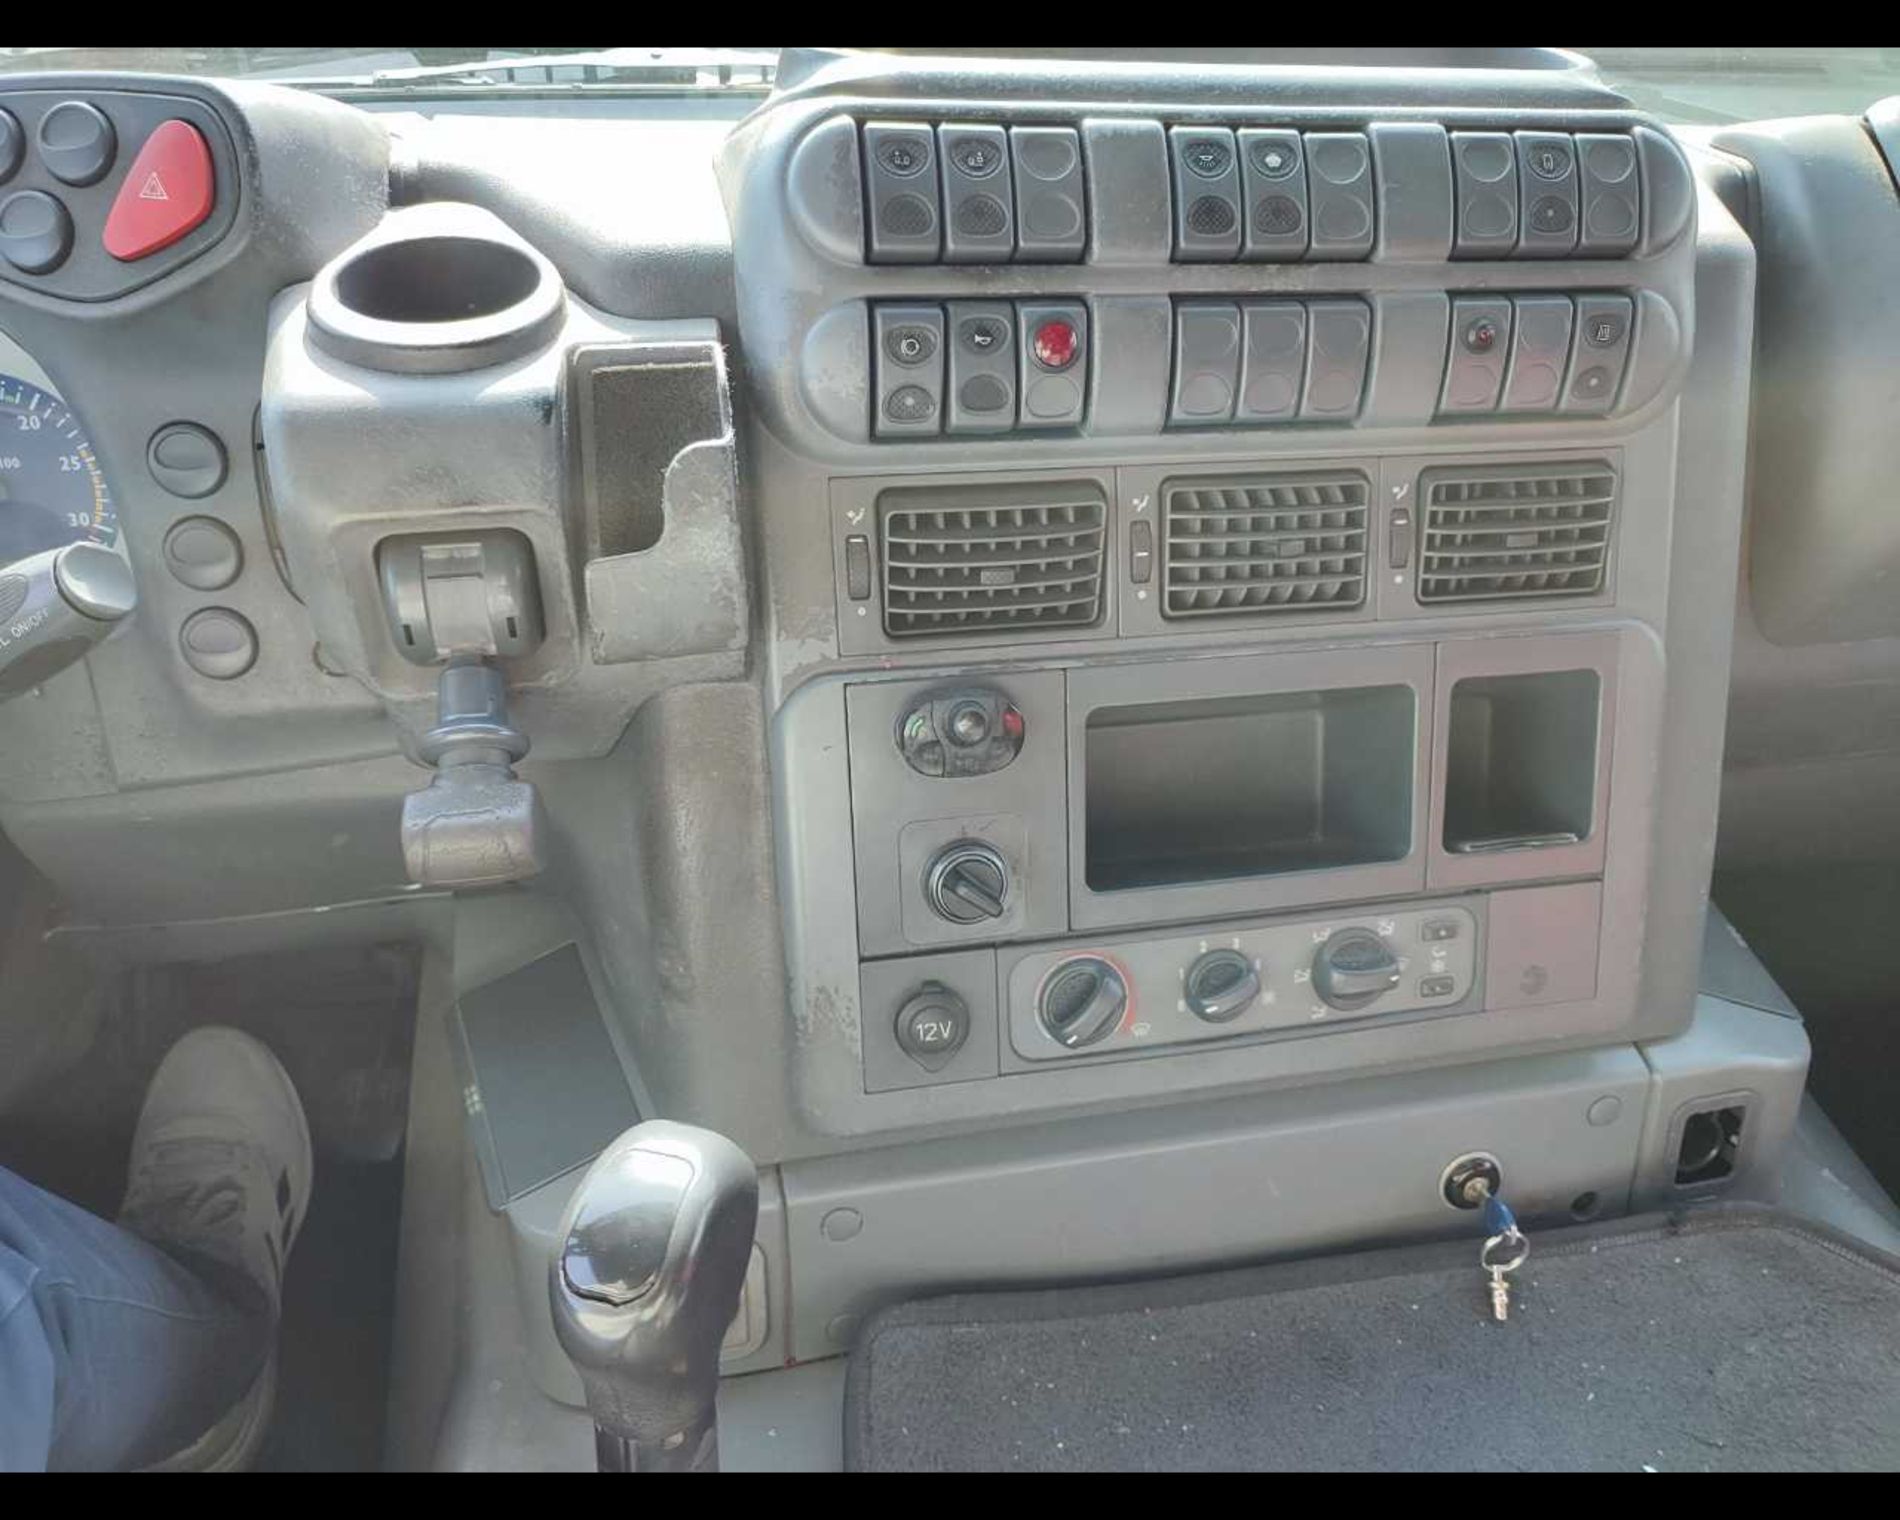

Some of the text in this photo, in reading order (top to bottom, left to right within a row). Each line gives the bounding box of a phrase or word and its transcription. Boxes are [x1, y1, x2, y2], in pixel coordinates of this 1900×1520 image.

[17, 415, 41, 431] 20
[59, 455, 82, 472] 25
[67, 512, 90, 527] 30
[916, 1020, 953, 1041] 12V
